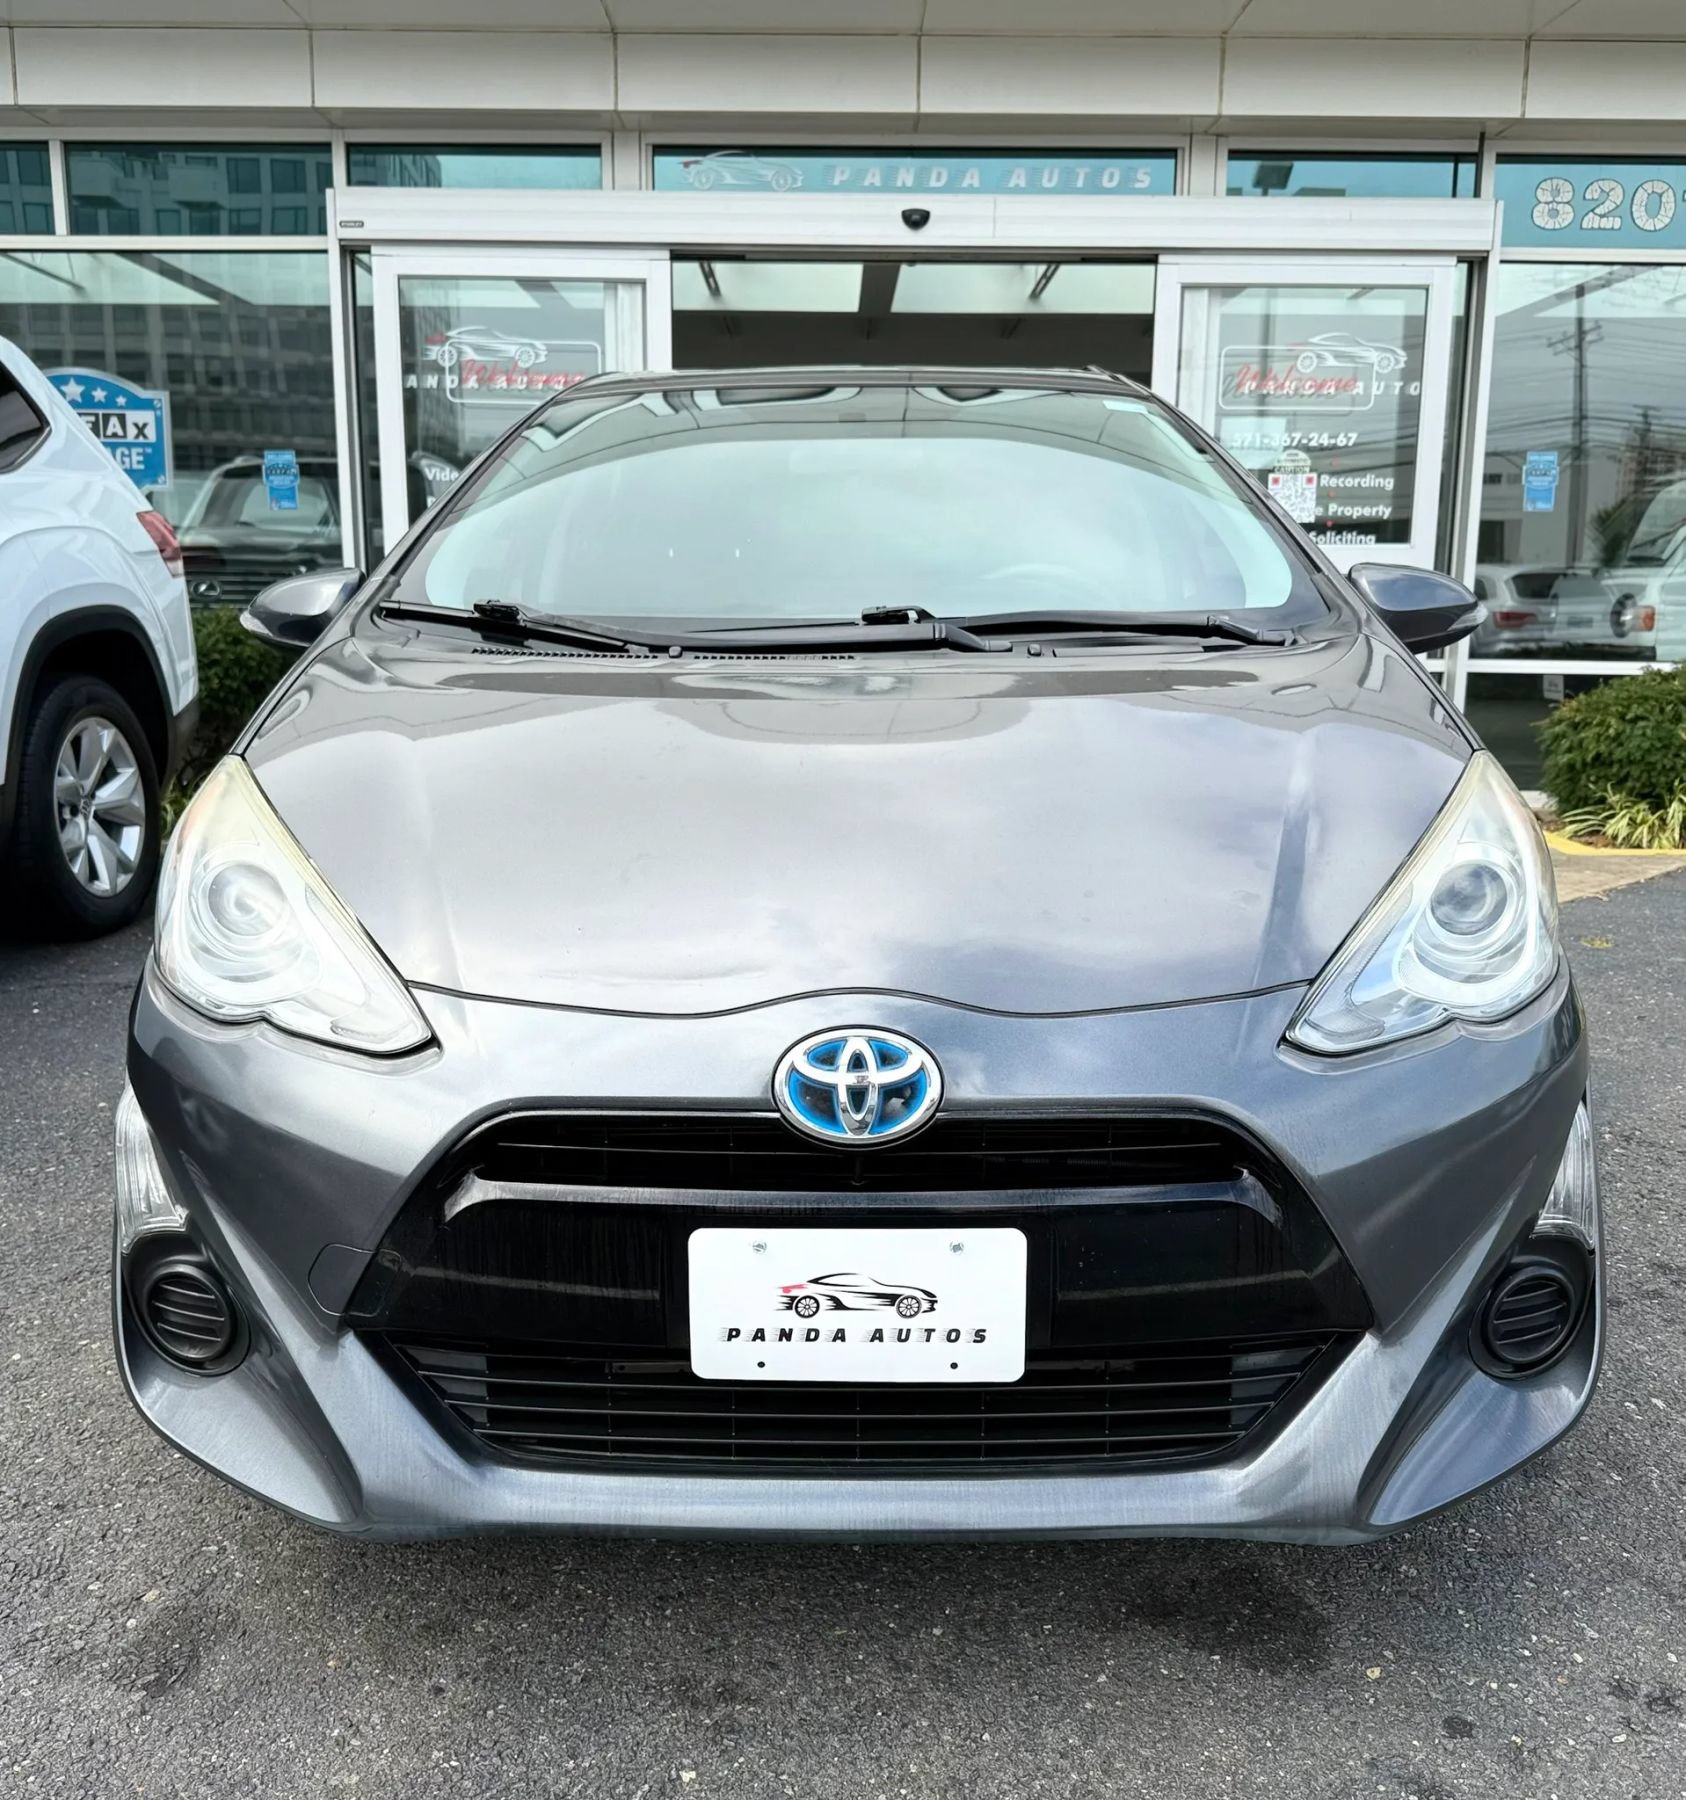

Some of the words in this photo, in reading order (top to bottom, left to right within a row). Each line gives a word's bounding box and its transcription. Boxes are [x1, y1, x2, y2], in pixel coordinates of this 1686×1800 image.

[829, 167, 981, 188] PANDA
[1006, 168, 1151, 189] AUTOS
[1531, 177, 1686, 232] 820
[1232, 432, 1358, 447] 571-367-24-67
[1320, 473, 1394, 491] Recording
[1328, 503, 1391, 520] Property
[722, 1327, 846, 1343] PANDA
[868, 1328, 986, 1343] AUTOS
